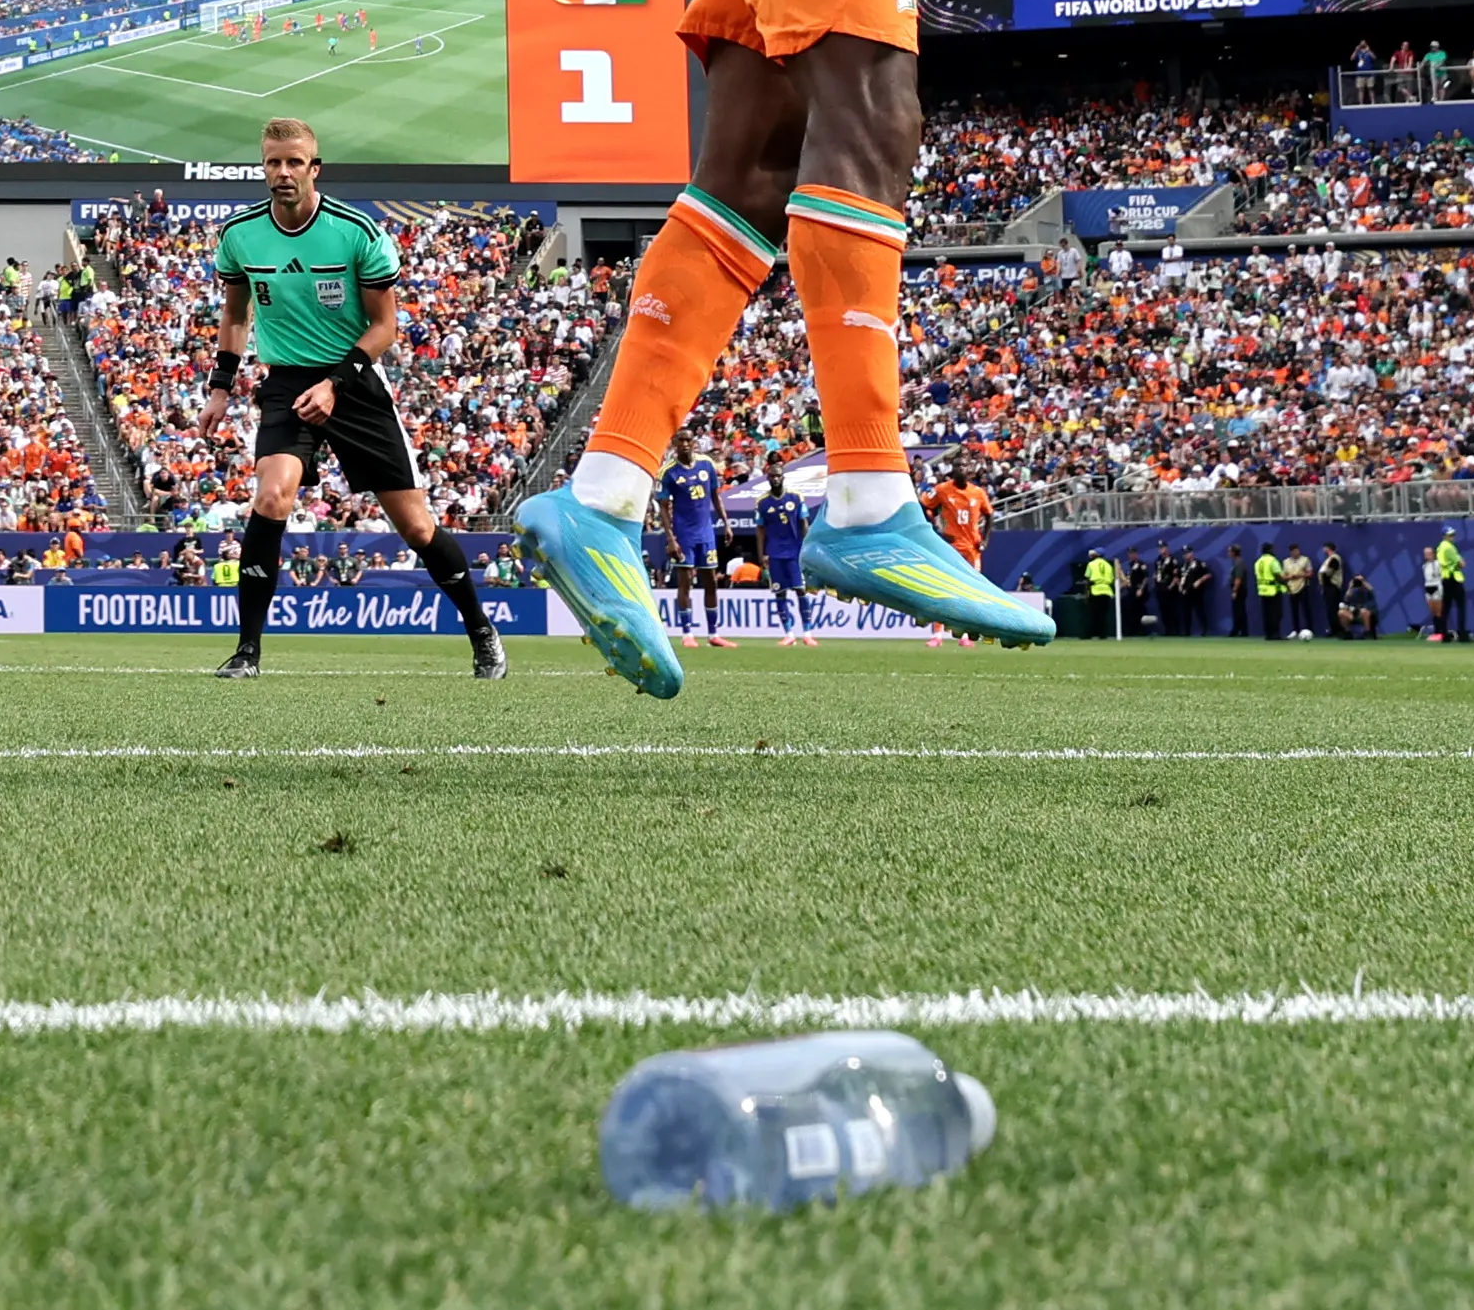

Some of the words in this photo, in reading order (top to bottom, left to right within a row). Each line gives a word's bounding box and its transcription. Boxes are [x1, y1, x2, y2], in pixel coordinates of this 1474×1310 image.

[1055, 0, 1093, 17] FIFA
[559, 50, 633, 123] 1
[184, 162, 265, 180] Hisens
[1128, 195, 1156, 207] FIFA
[80, 204, 119, 219] FIFA
[194, 204, 233, 219] CUP
[1108, 206, 1153, 218] ORLD
[1154, 206, 1179, 217] CUP
[318, 282, 342, 291] FIFA
[779, 512, 789, 524] 5
[77, 594, 203, 626] FOOTBALL
[211, 594, 298, 626] UNES
[303, 590, 353, 629] the
[356, 590, 441, 633] World
